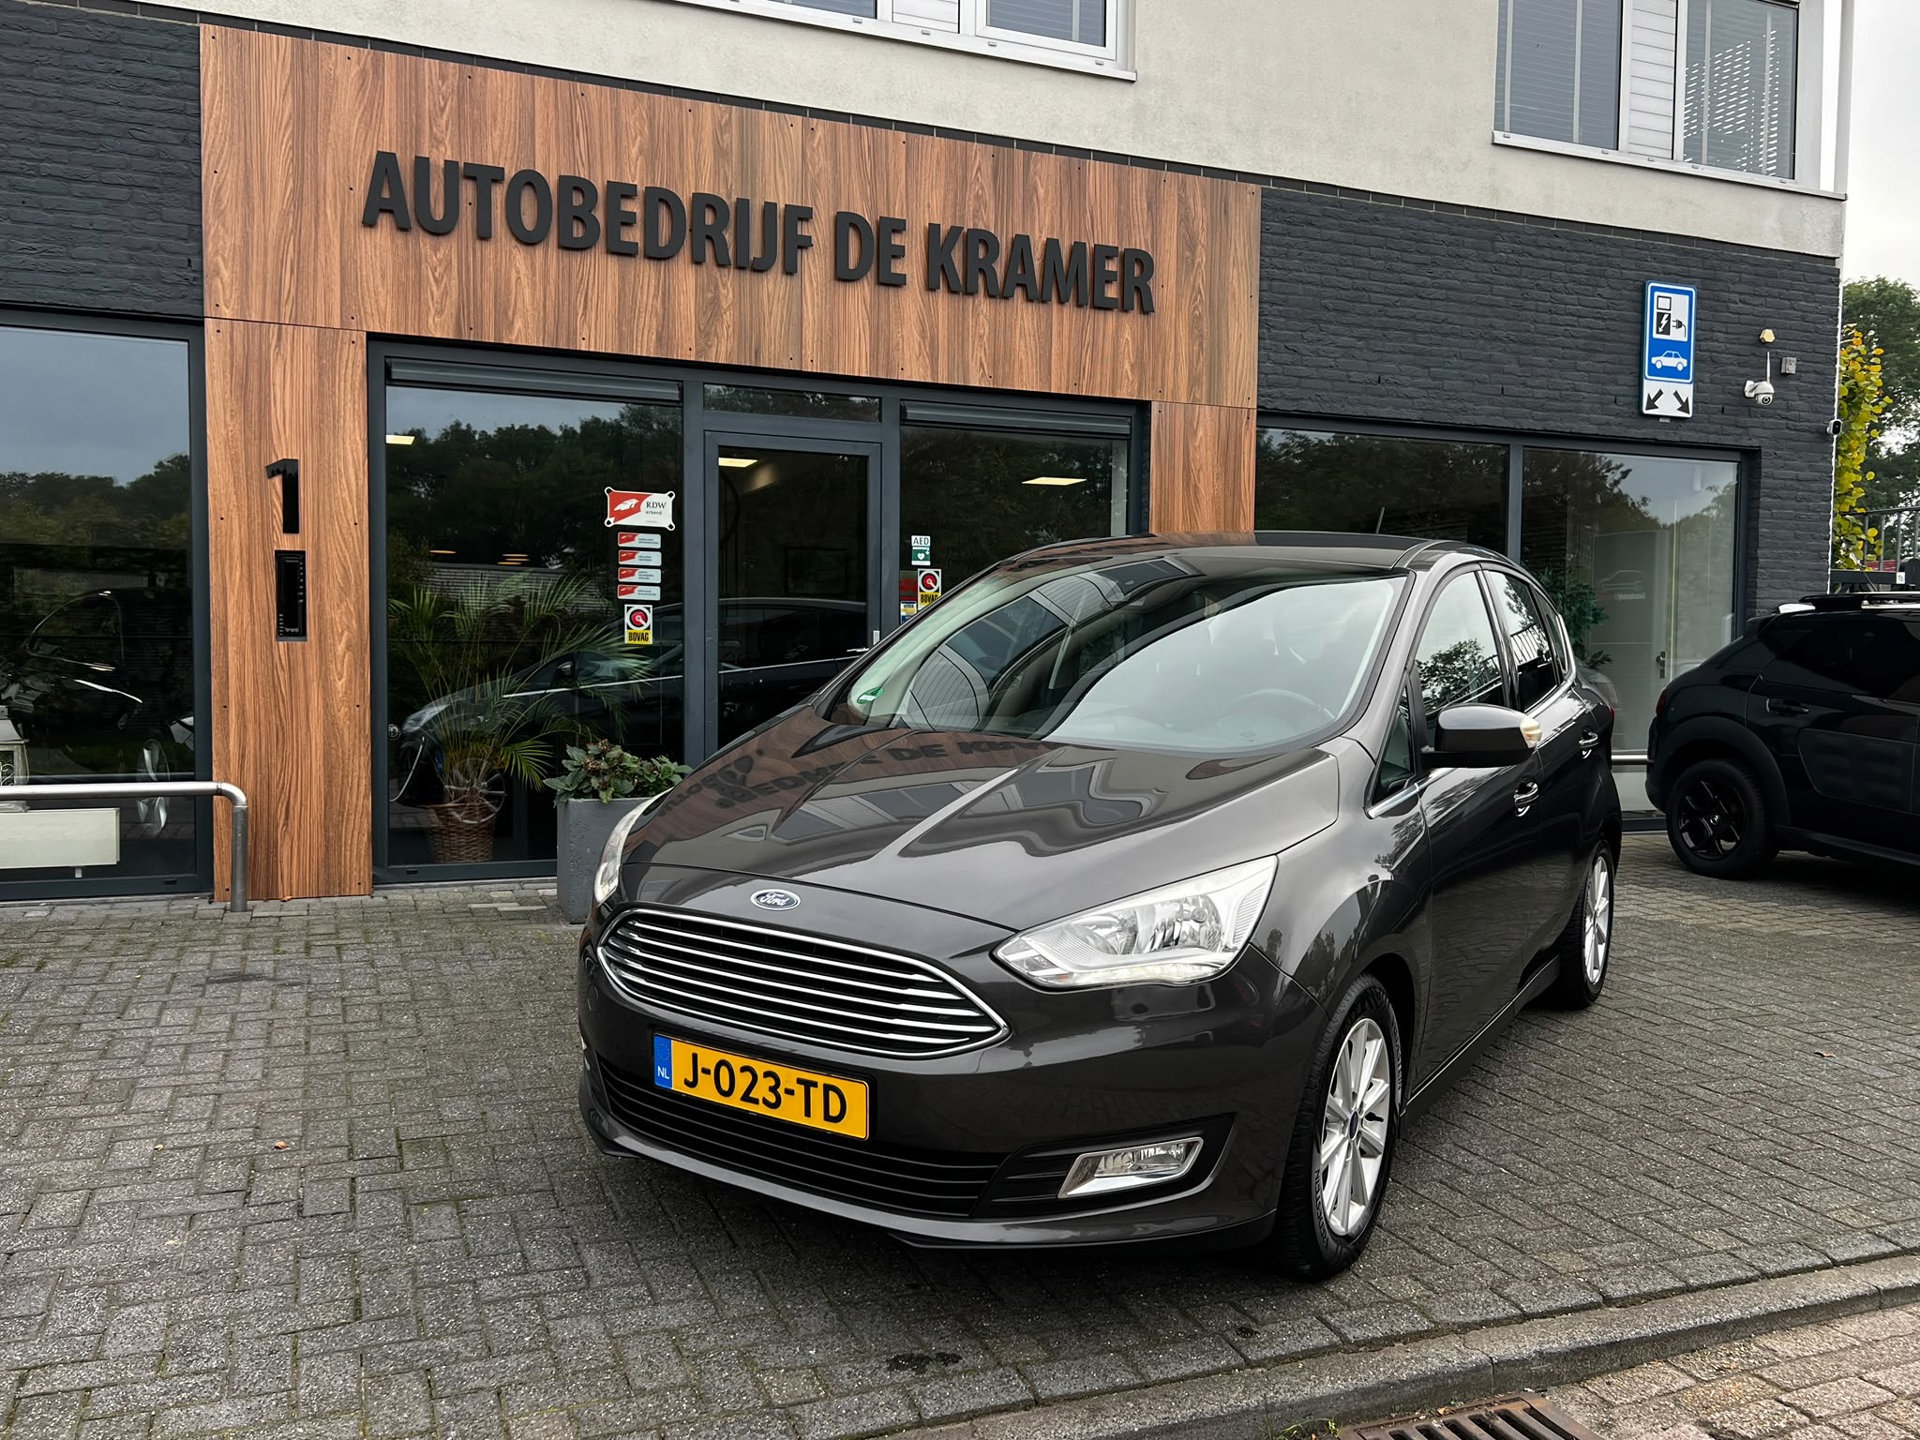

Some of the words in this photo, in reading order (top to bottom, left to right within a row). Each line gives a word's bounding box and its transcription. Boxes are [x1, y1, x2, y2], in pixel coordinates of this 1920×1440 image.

[362, 150, 813, 276] AUTOBEDRIJF
[834, 211, 907, 287] DE
[926, 222, 1156, 313] KRAMER
[265, 458, 300, 534] 1
[646, 501, 666, 509] RDW
[912, 537, 929, 545] AED
[628, 631, 650, 642] BOVAG
[760, 892, 790, 906] Ford
[657, 1066, 670, 1079] NL
[684, 1052, 847, 1124] J-023-TD
